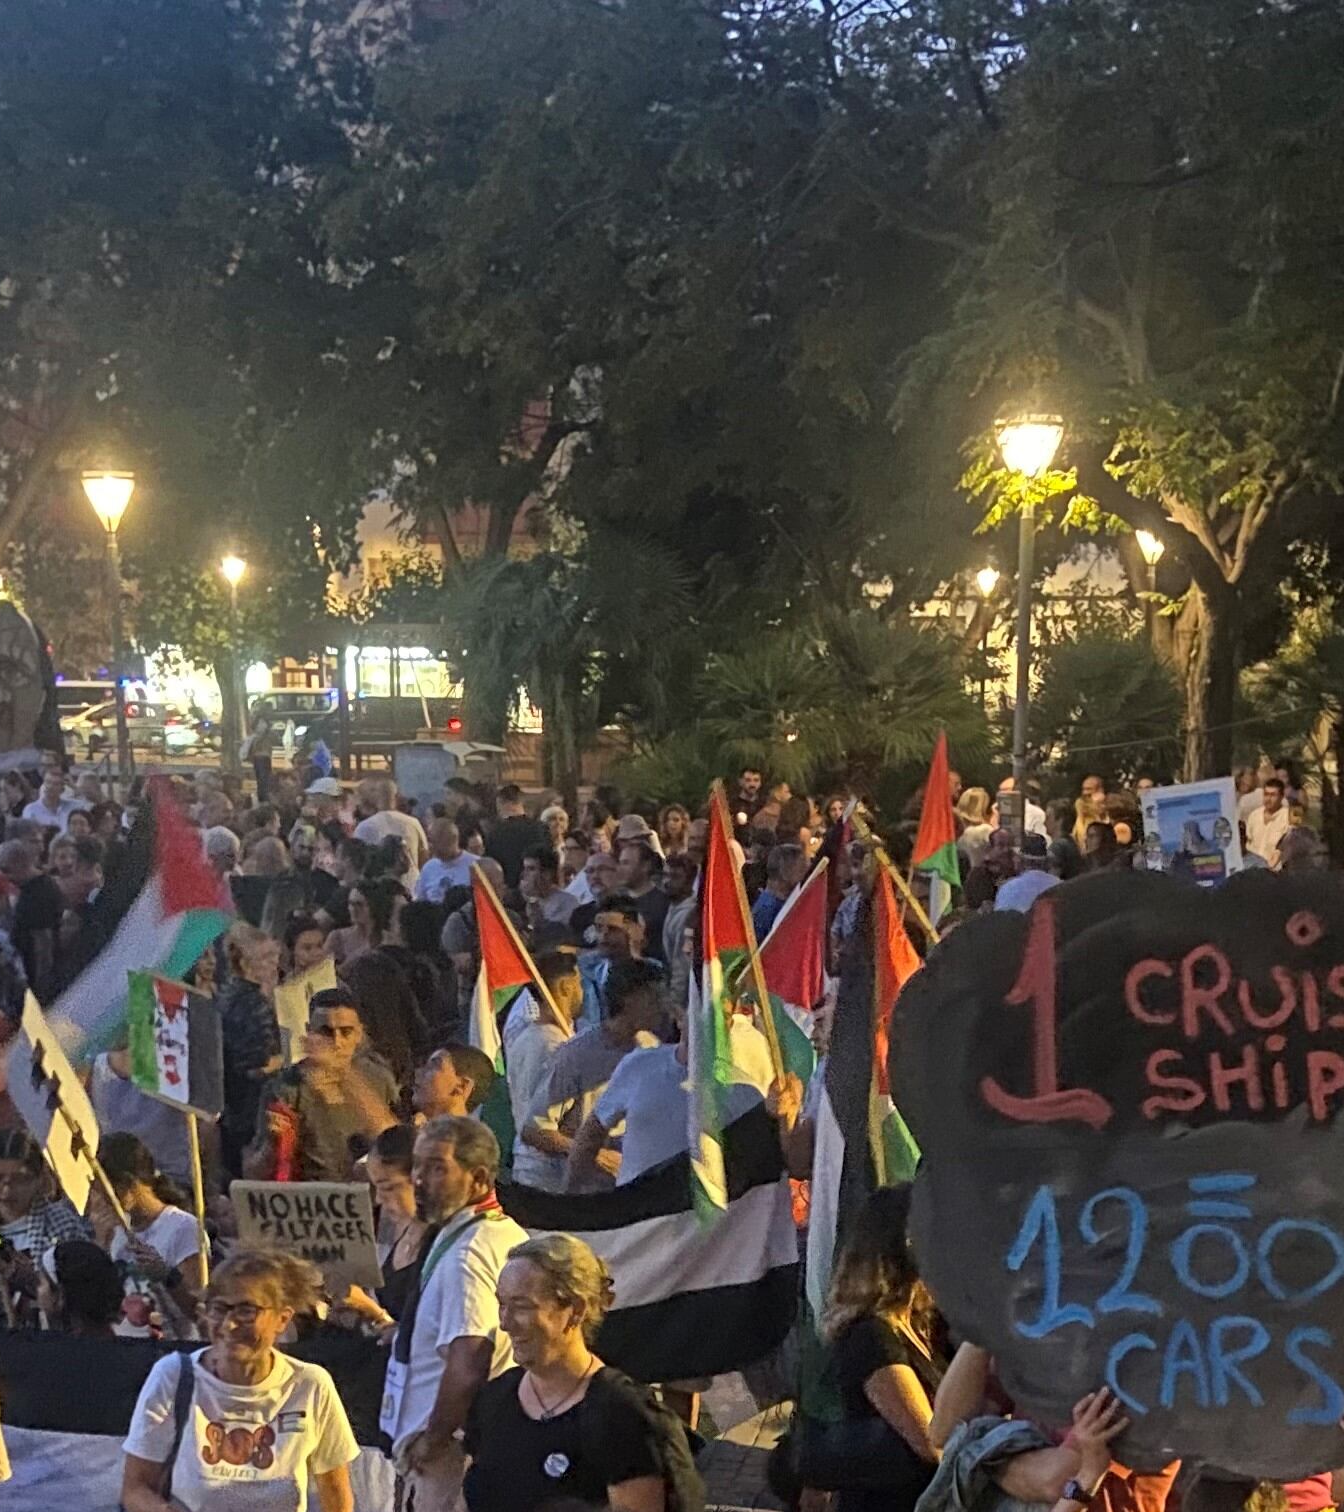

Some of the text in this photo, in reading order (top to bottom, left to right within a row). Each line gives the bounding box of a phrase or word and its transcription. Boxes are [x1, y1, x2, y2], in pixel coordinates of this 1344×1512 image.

[979, 897, 1114, 1131] 1
[247, 1191, 360, 1220] NO HACE
